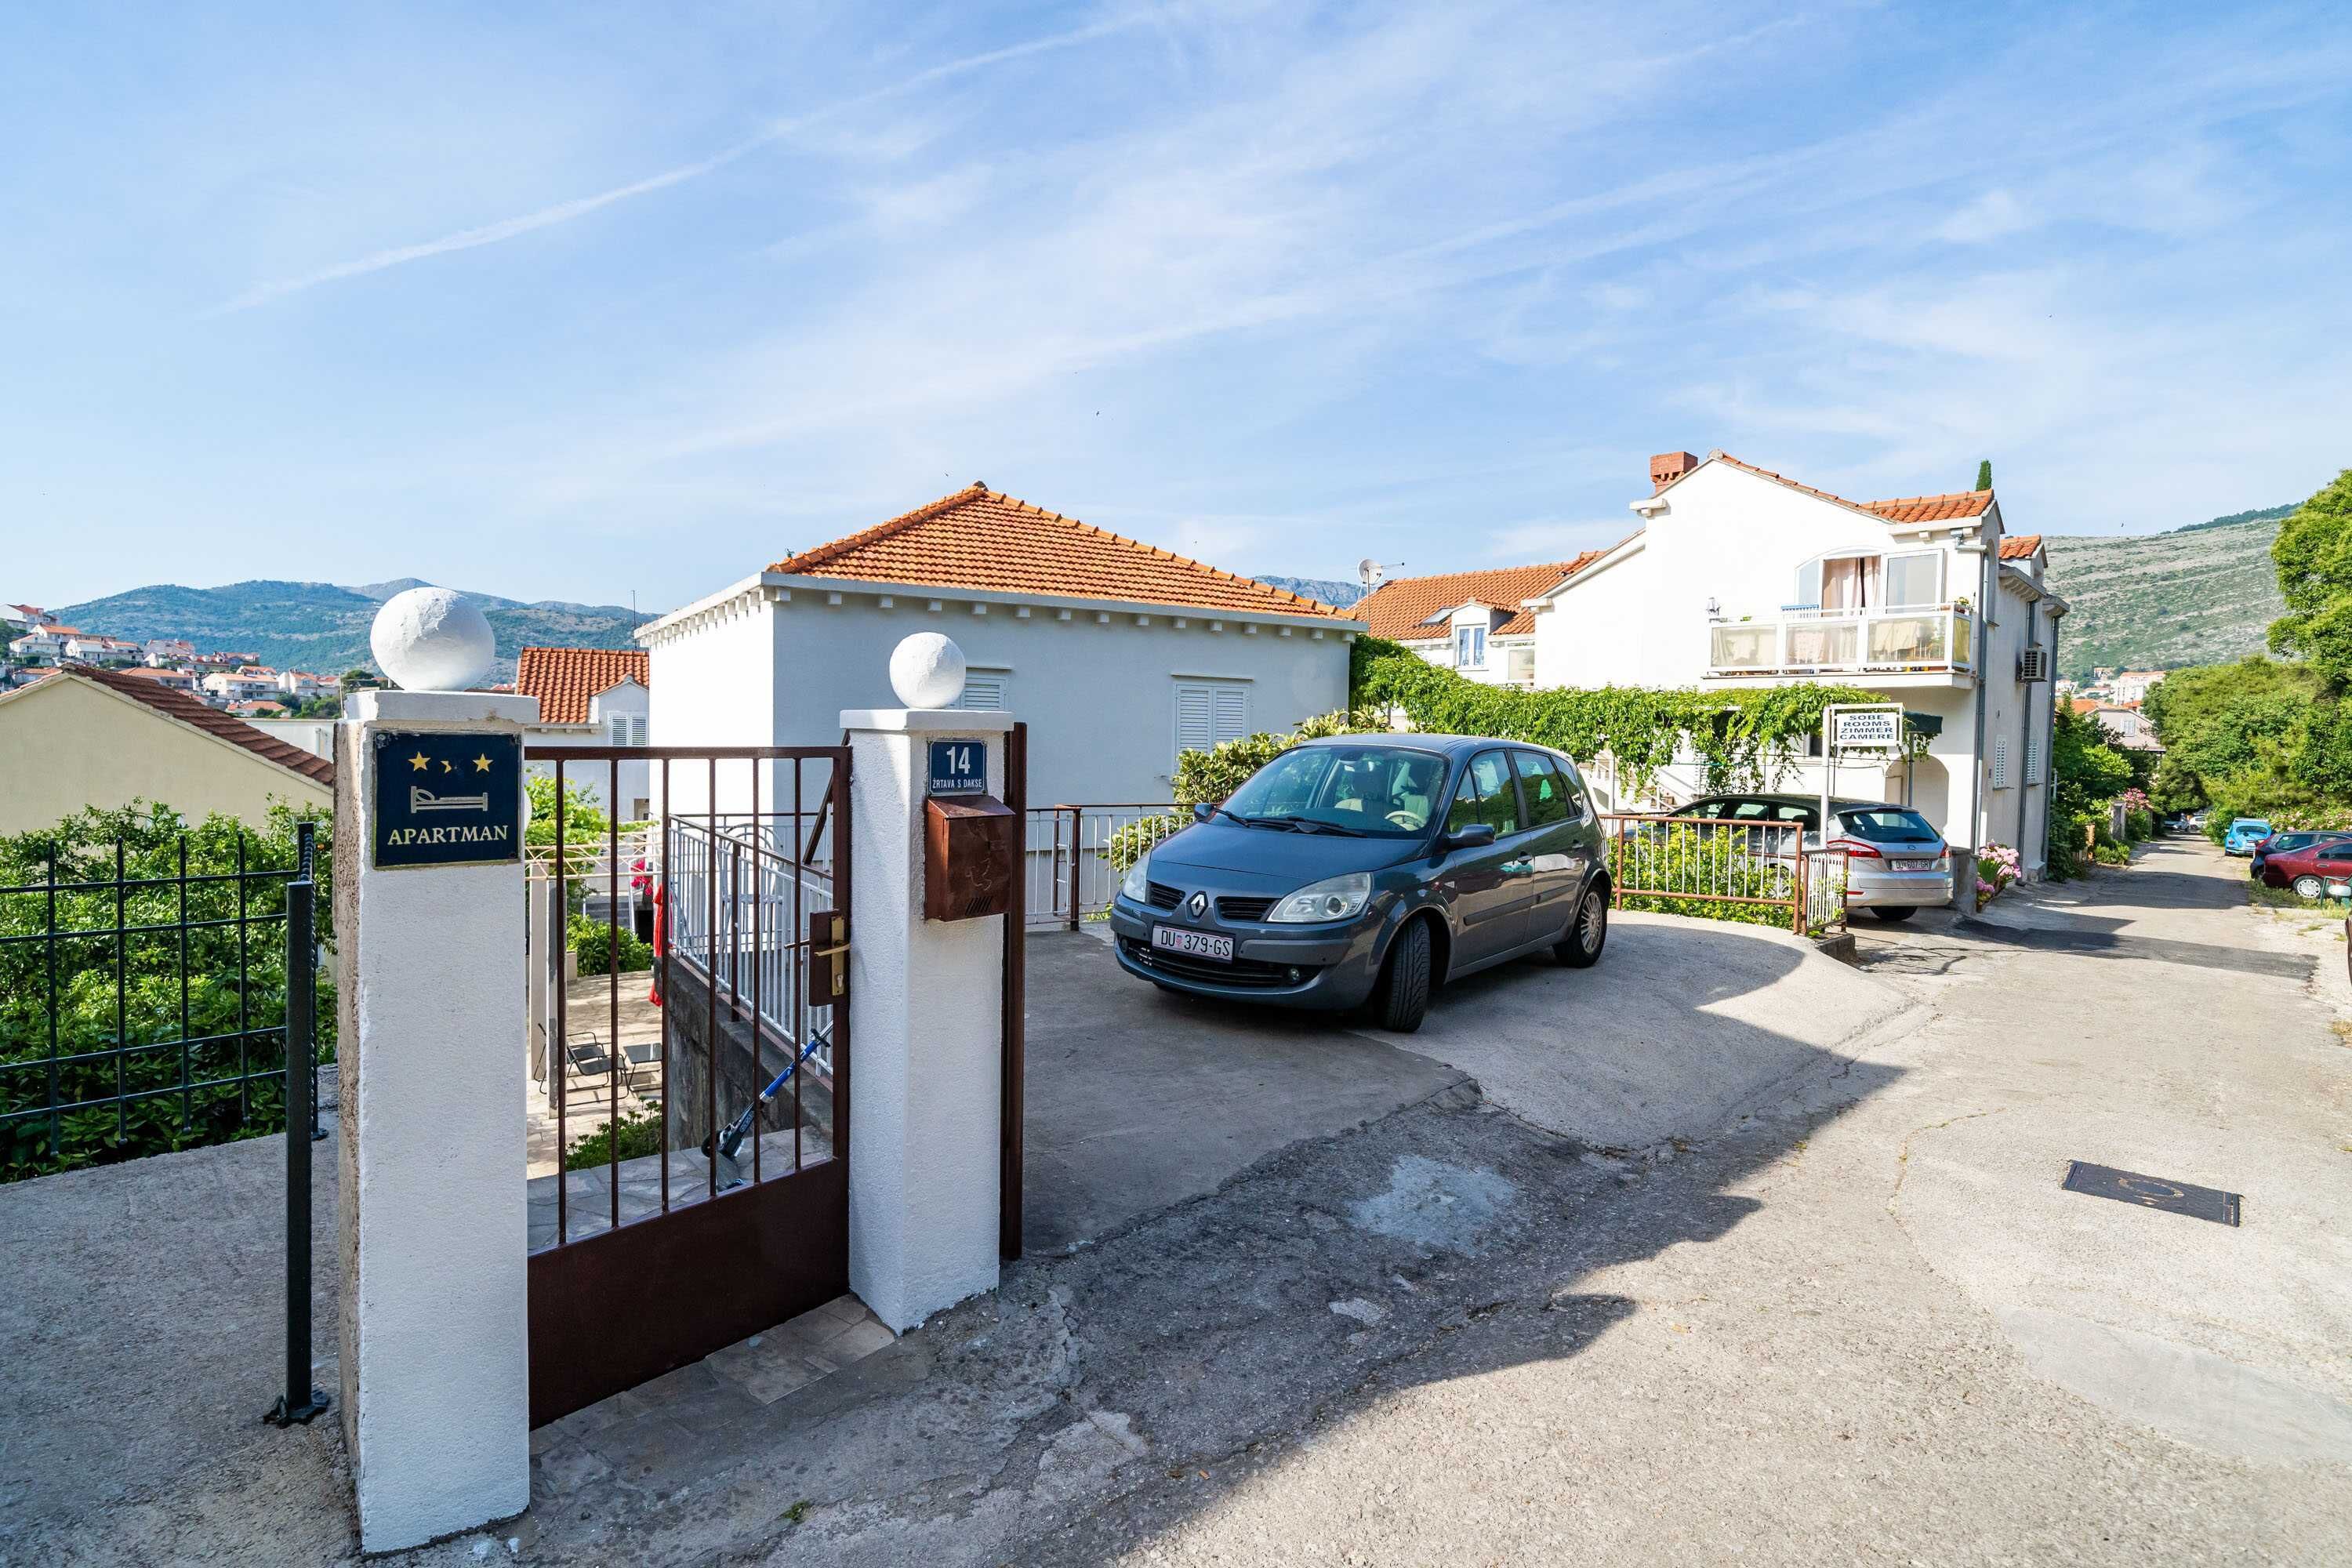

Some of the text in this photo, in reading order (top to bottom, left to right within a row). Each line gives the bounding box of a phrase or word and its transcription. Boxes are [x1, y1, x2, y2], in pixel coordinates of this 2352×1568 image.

[946, 746, 971, 775] 14
[932, 777, 982, 789] ŽRTAVA S DAKSE
[387, 825, 509, 846] APARTMAN
[1160, 930, 1230, 956] DU 379-GS
